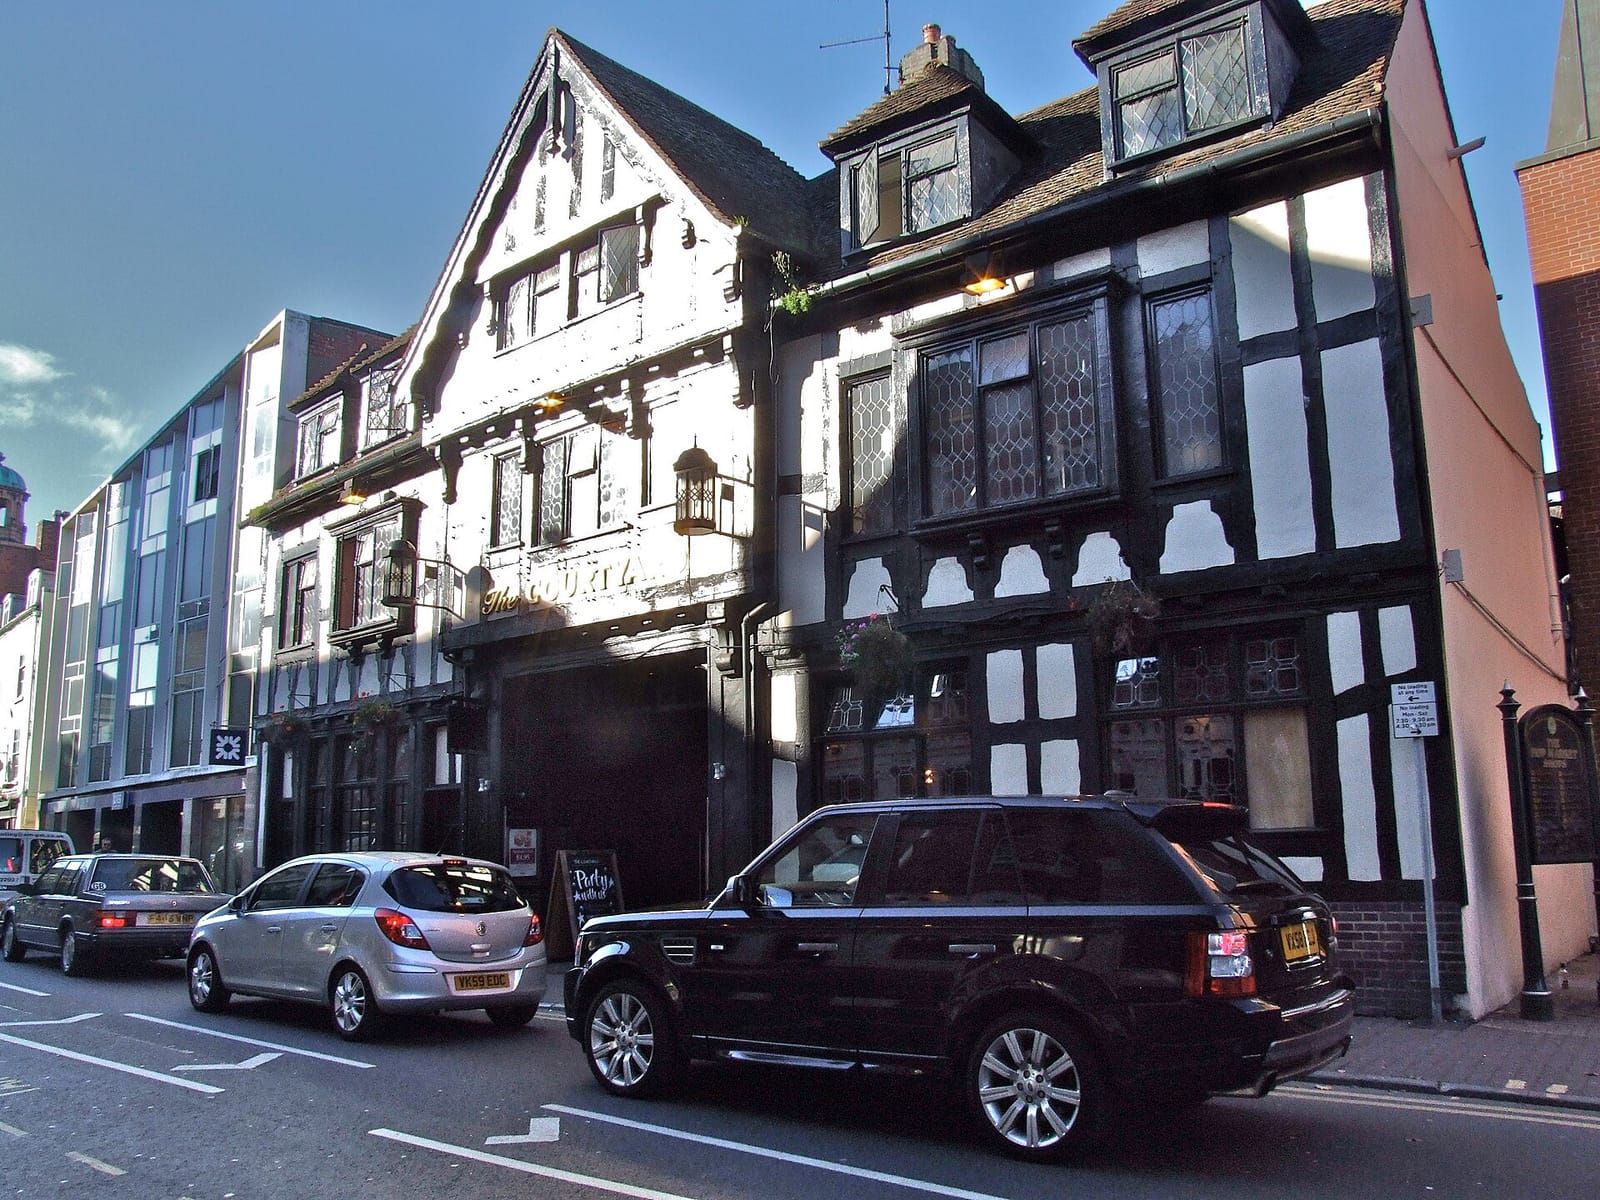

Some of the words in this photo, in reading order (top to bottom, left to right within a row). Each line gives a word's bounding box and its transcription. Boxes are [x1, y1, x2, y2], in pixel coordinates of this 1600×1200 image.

[482, 586, 520, 615] The
[574, 868, 608, 893] Party
[459, 975, 485, 988] VK59
[486, 974, 506, 987] EDC
